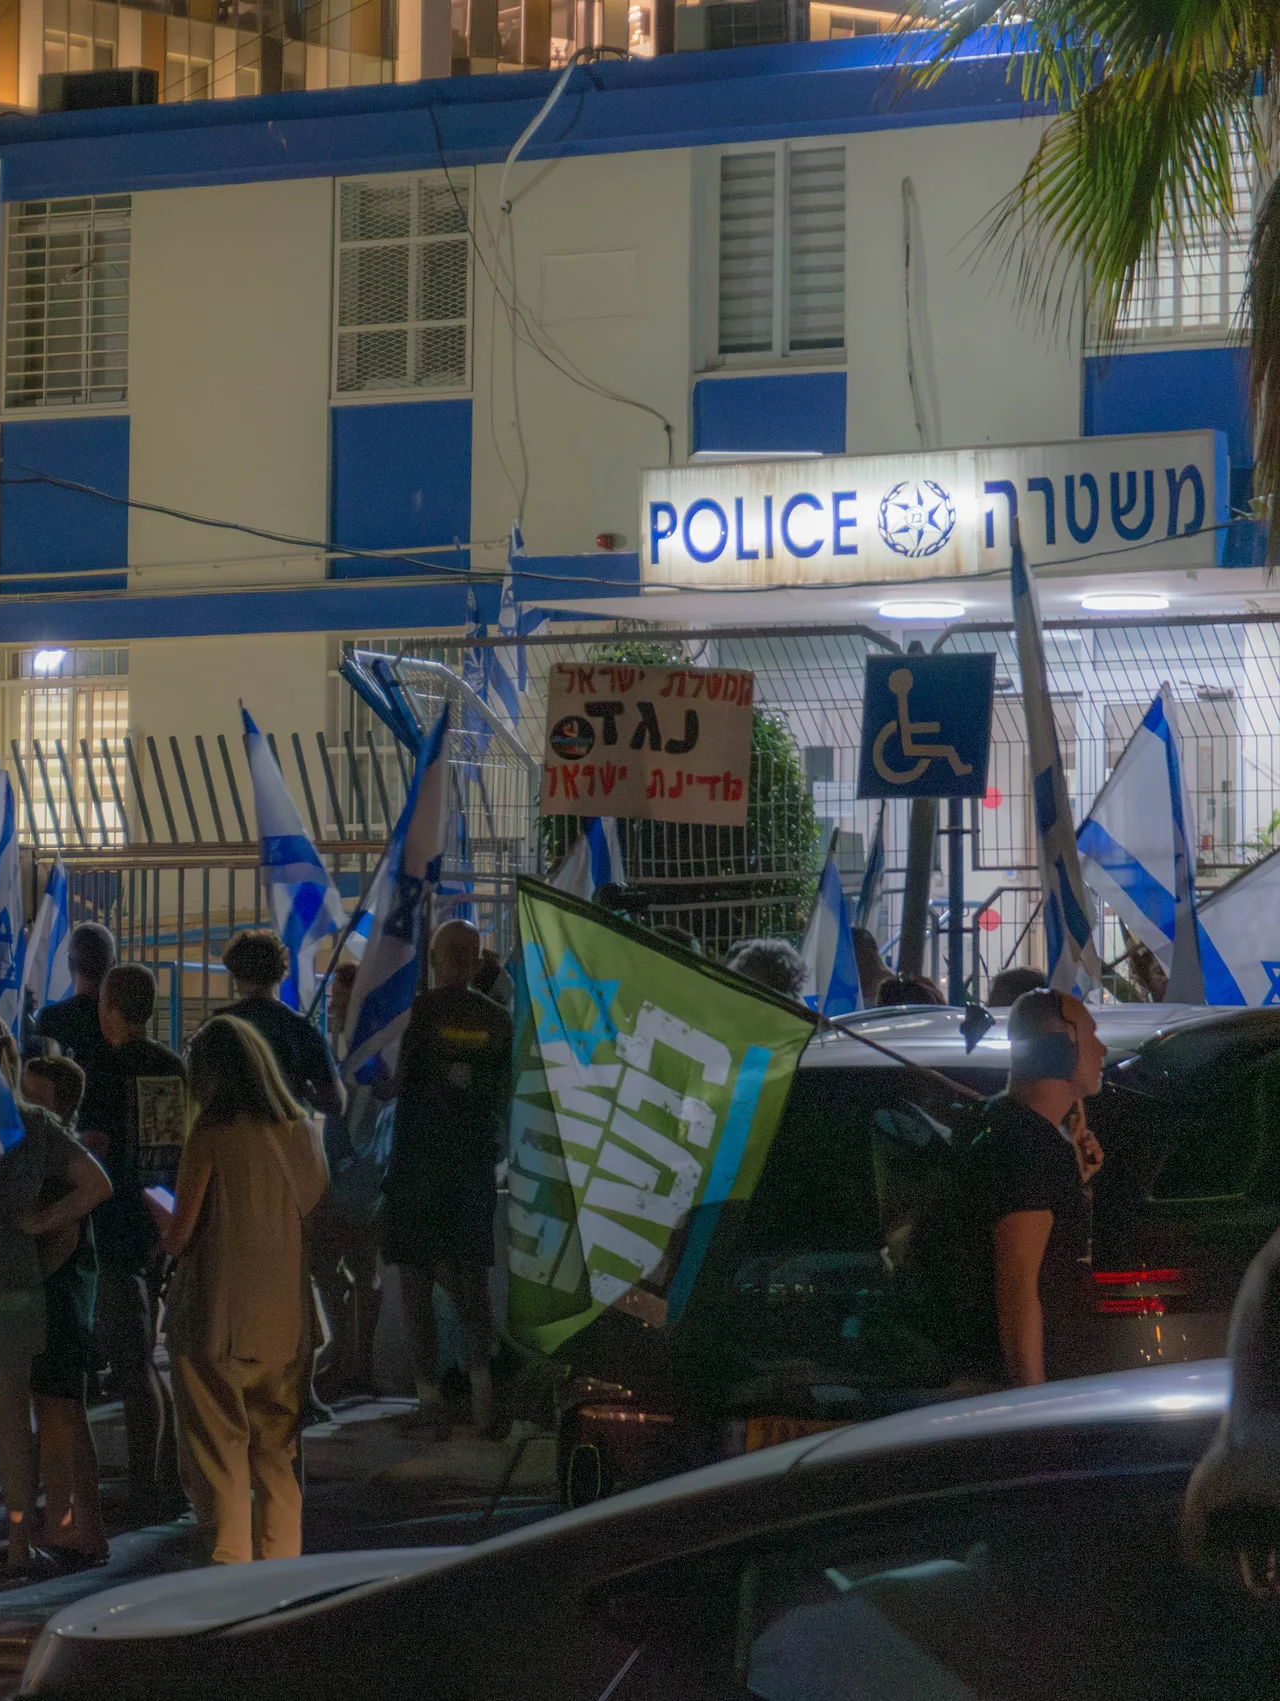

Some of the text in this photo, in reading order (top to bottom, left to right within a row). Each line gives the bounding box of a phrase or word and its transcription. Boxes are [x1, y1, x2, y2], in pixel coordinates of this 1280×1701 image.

[650, 491, 858, 564] POLICE
[983, 464, 1205, 549] משטרה
[558, 665, 754, 706] ממשלת ישראל
[584, 701, 699, 754] נגד
[544, 761, 744, 801] מדינת ישראל
